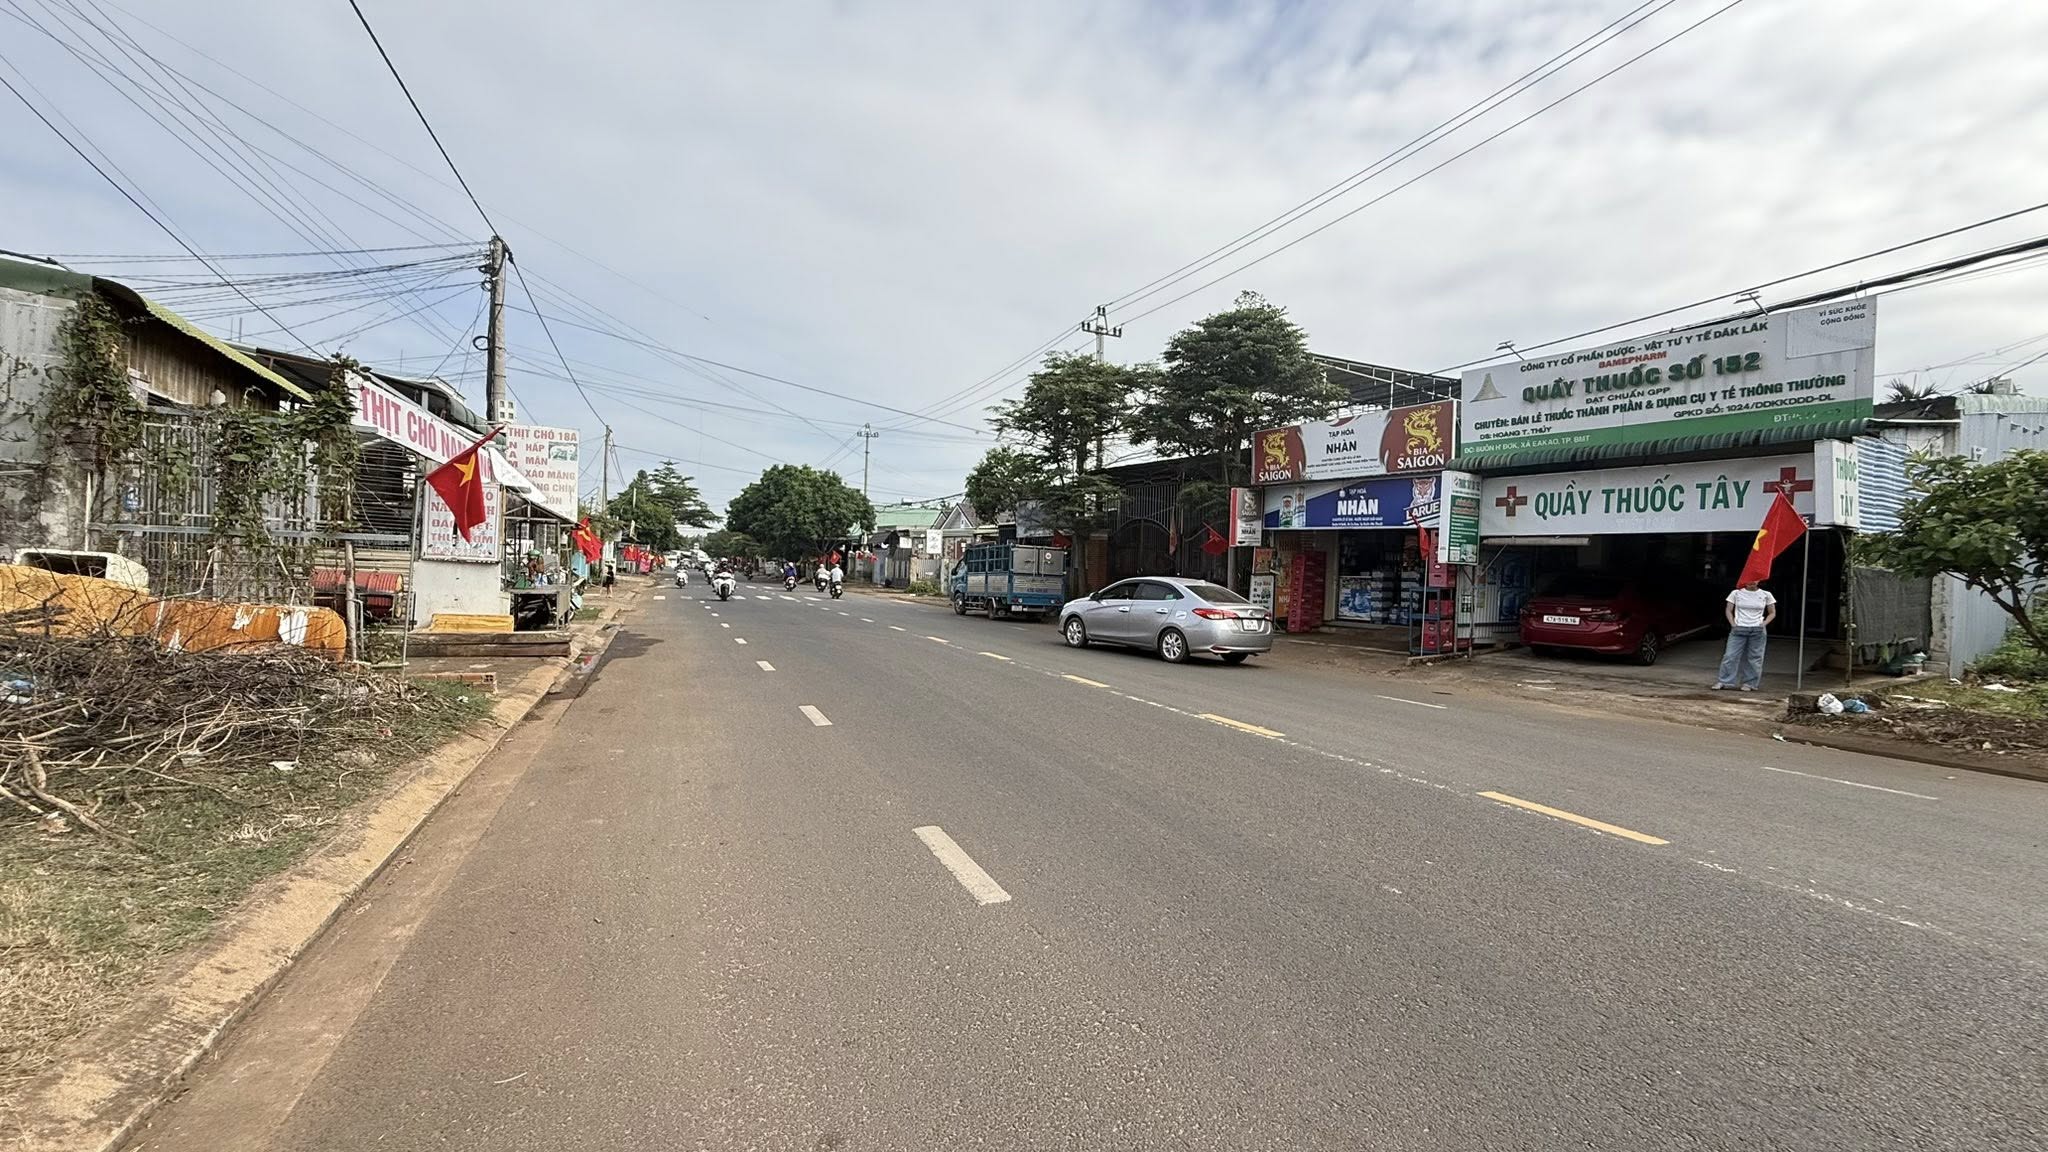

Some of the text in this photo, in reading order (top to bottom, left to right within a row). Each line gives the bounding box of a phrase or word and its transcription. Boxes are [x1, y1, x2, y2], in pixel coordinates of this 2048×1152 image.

[1520, 362, 1545, 372] CÔNG
[1547, 359, 1559, 368] TY
[1644, 339, 1663, 352] VẬT
[1667, 336, 1683, 347] TƯ
[1685, 335, 1693, 344] Y
[1696, 329, 1712, 341] TẾ
[1522, 352, 1762, 403] QUẦY THUỐC SỐ 152
[1648, 386, 1671, 395] GPP
[1511, 413, 1530, 426] BÁN
[1532, 411, 1543, 423] LẺ
[1545, 407, 1574, 421] THUỐC
[1576, 404, 1609, 419] THÀNH
[1645, 399, 1654, 410] &
[1656, 395, 1687, 409] DỤNG
[1690, 392, 1706, 405] CỤ
[1709, 391, 1718, 402] Y
[1721, 385, 1736, 400] TẾ
[1739, 382, 1783, 398] THÔNG
[1787, 374, 1846, 392] THƯỜNG
[1705, 403, 1724, 414] SỐ:
[359, 384, 401, 437] THỊT
[407, 410, 437, 453] CHÓ
[508, 427, 577, 442] THỊT CHÓ 18A
[1328, 431, 1339, 439] TẠP
[1574, 434, 1591, 443] BMT
[1326, 439, 1357, 454] NHÀN
[1413, 447, 1428, 456] BIA
[1397, 453, 1445, 469] SAIGON
[1836, 453, 1858, 482] THUỐC
[1258, 469, 1292, 481] SAIGON
[1337, 495, 1379, 516] NHÀN
[1534, 474, 1751, 520] QUẦY THUỐC TÂY
[1840, 490, 1854, 517] TÂY
[1406, 500, 1441, 520] LARUE
